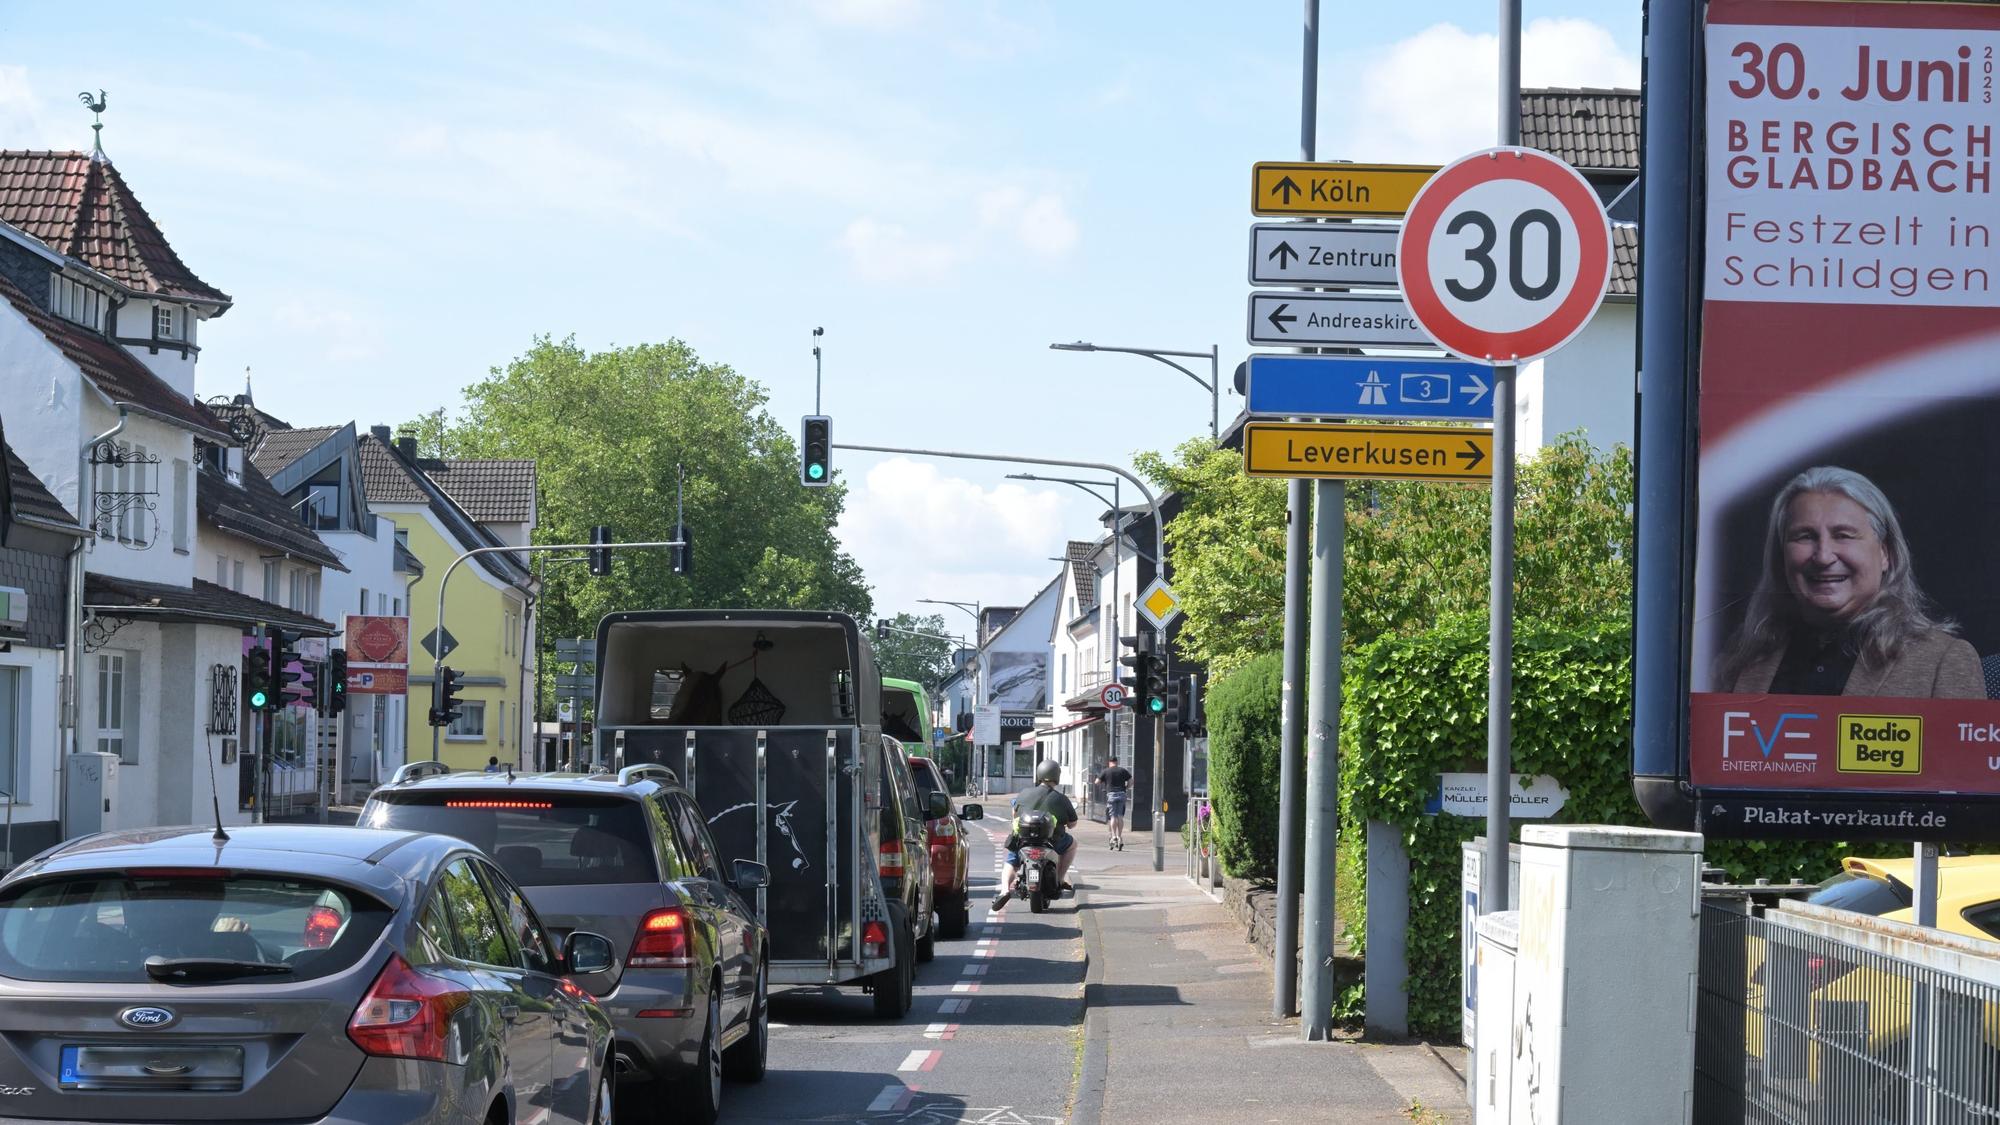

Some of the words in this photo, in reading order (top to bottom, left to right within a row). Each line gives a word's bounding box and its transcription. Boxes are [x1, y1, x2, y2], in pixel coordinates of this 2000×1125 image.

[1728, 41, 1820, 101] 30.
[1841, 45, 1971, 103] Juni
[1982, 46, 1993, 104] 2023
[1728, 120, 1991, 158] BERGISCH
[1727, 156, 1990, 194] GLADBACH
[1310, 178, 1370, 203] Köln
[1727, 212, 1923, 246] Festzelt
[1949, 216, 1990, 248] in
[1444, 208, 1561, 302] 30
[1723, 255, 1989, 297] Schildgen
[1420, 380, 1431, 399] 3
[1287, 439, 1447, 467] Leverkusen
[362, 674, 373, 686] P
[1106, 690, 1122, 703] 30
[1850, 722, 1911, 743] Radio
[1722, 760, 1817, 773] ENTERTAINMENT
[1856, 744, 1904, 768] Berg
[1509, 794, 1549, 804] ÖLLER
[1743, 806, 1947, 829] Plakat-verkauft.de
[132, 1011, 161, 1024] Ford
[65, 1068, 72, 1077] D
